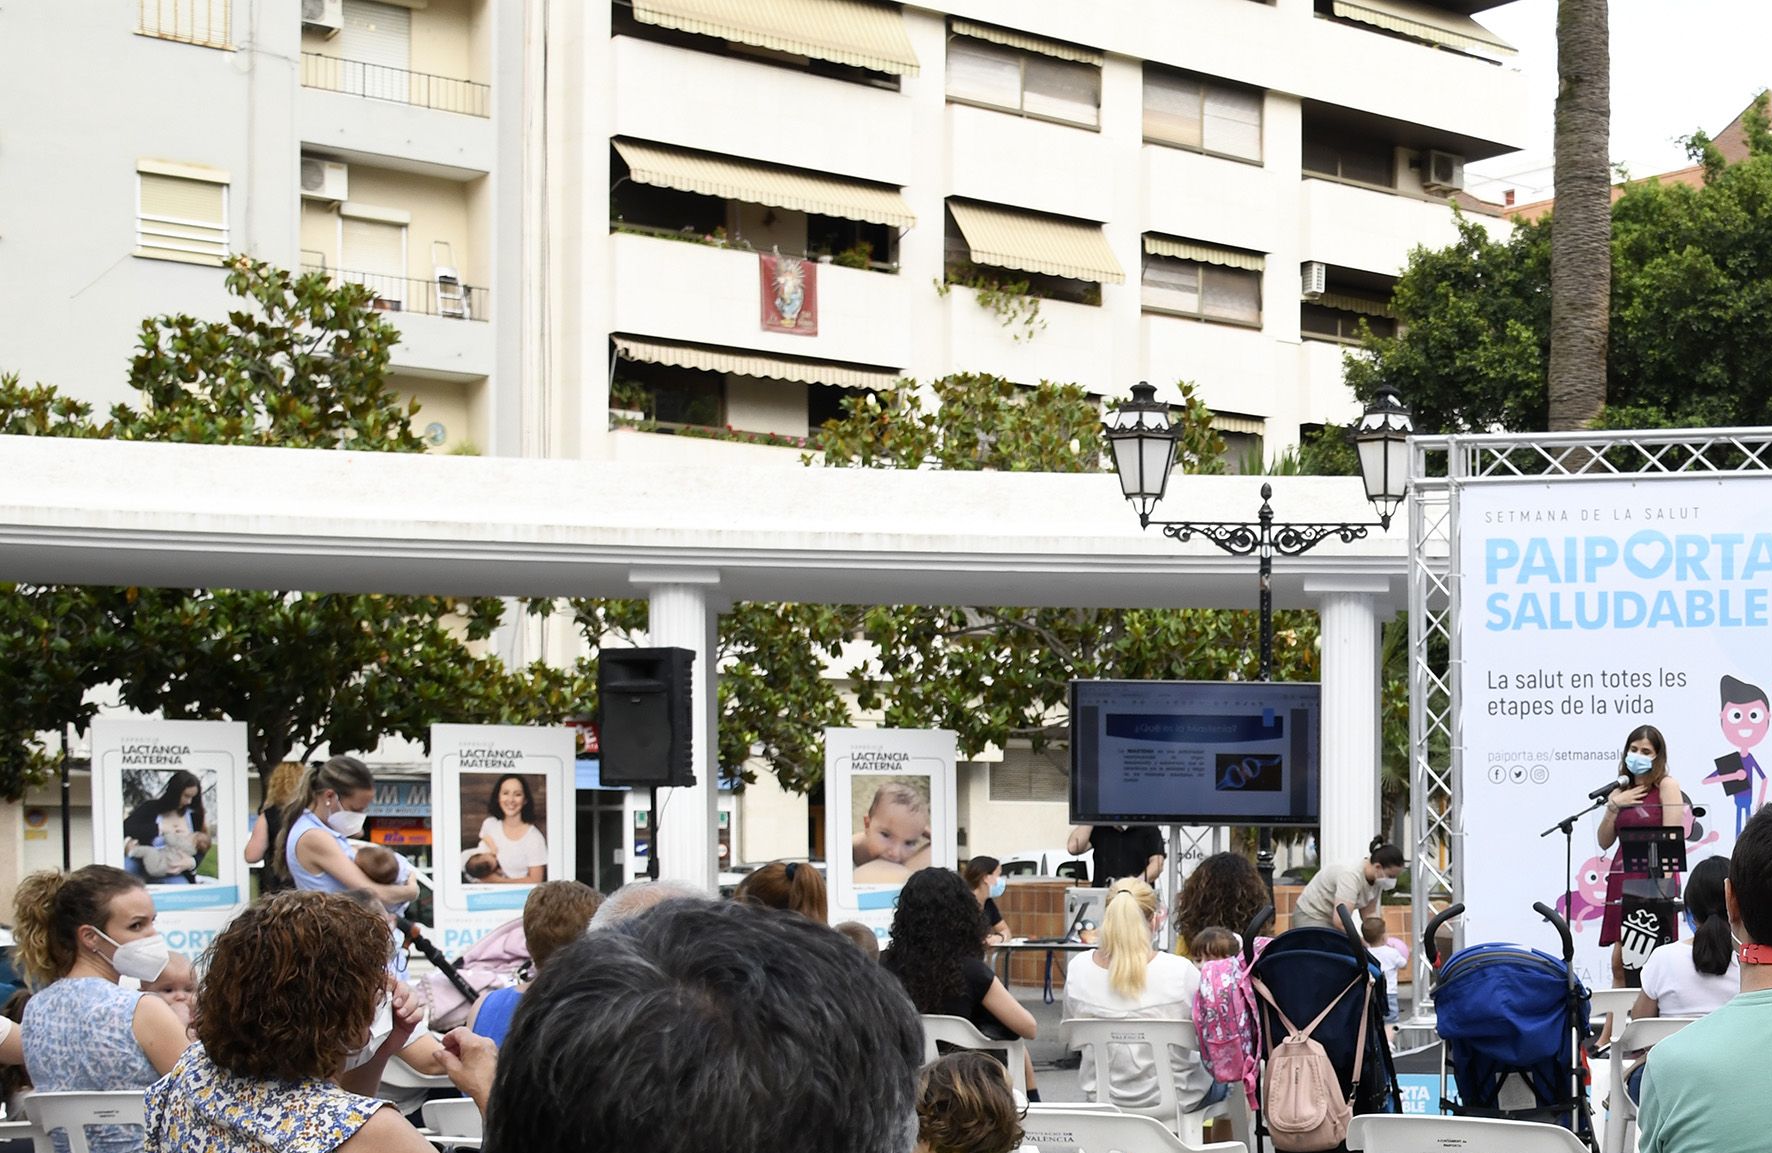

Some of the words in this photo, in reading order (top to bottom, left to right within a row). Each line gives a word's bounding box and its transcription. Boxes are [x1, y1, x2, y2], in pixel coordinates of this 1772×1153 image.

[1484, 509, 1569, 524] SETMANA
[1580, 508, 1601, 522] DE
[1613, 508, 1633, 521] LA
[1644, 506, 1701, 520] SALUT
[1485, 588, 1769, 632] SALUDABLE
[1487, 670, 1509, 690] La
[1515, 669, 1564, 690] salut
[1570, 673, 1594, 689] en
[1600, 669, 1653, 688] totes
[1659, 667, 1688, 688] les
[1487, 698, 1555, 720] etapes
[1560, 695, 1584, 715] de
[1591, 694, 1607, 714] la
[1614, 694, 1655, 715] vida
[121, 755, 183, 765] MATERNA
[459, 759, 516, 768] MATERNA
[851, 761, 903, 771] MATERNA
